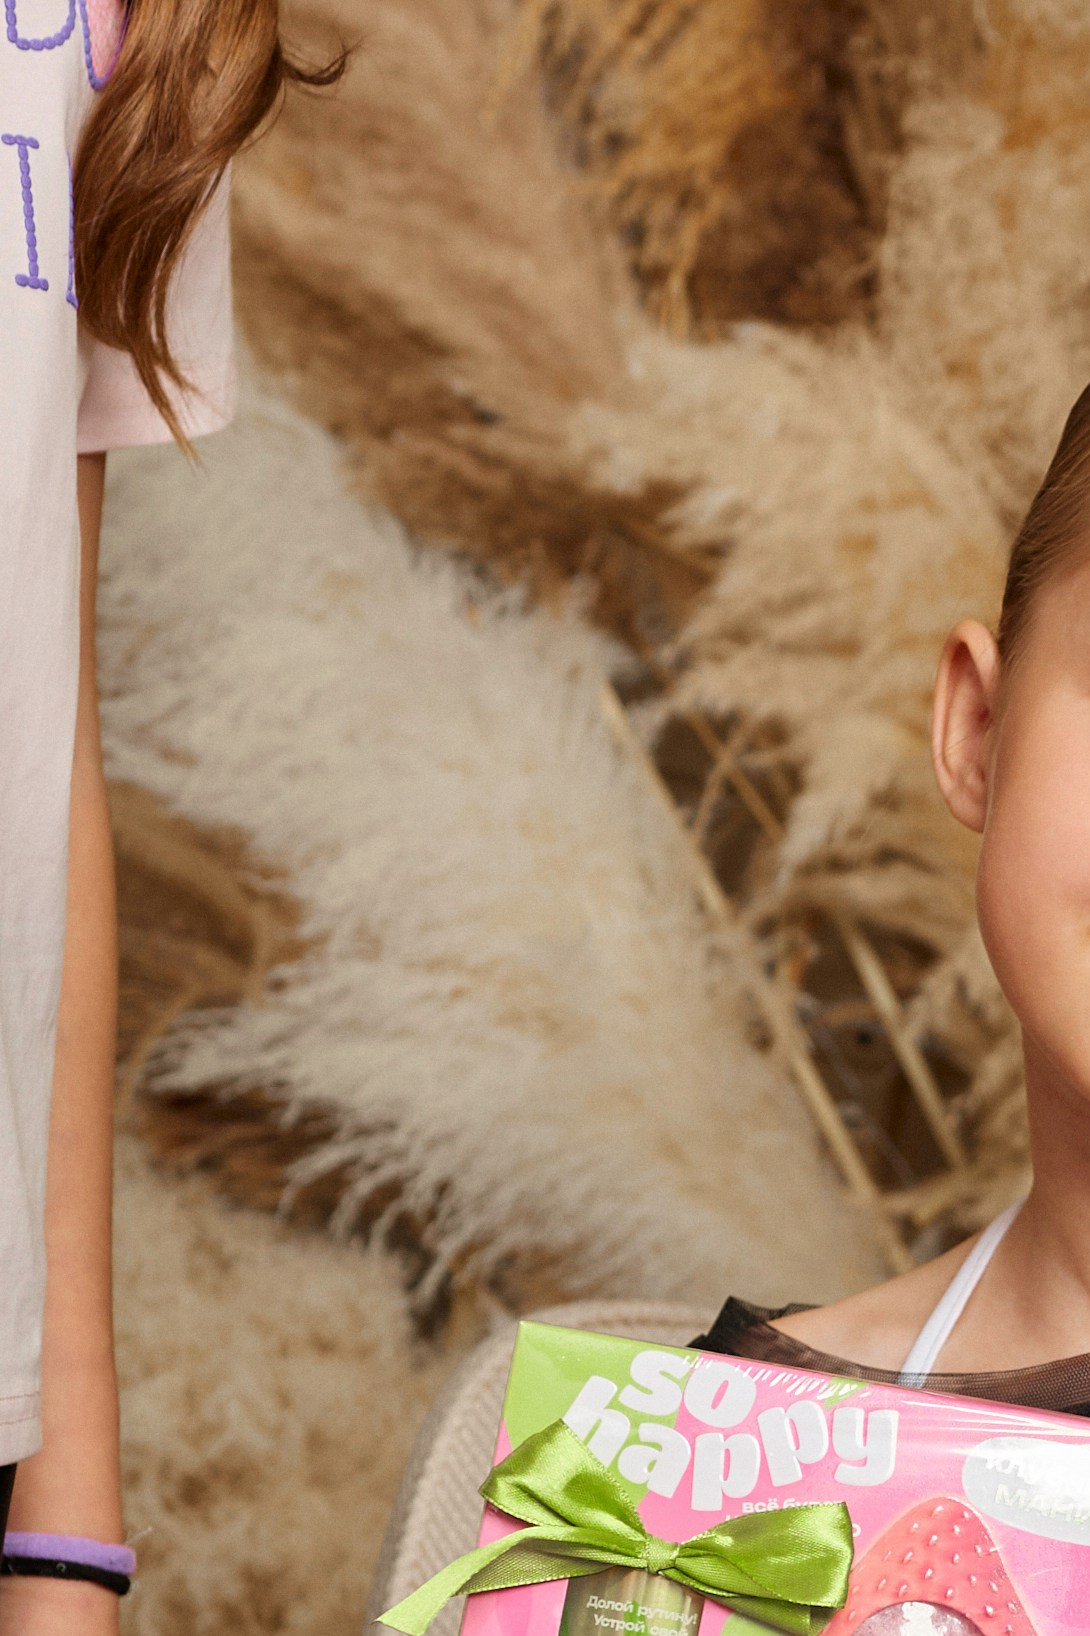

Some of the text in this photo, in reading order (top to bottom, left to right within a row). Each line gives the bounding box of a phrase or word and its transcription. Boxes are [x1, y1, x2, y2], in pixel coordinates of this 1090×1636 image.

[562, 1374, 900, 1512] happy
[586, 1595, 698, 1626] Долой рутину!
[594, 1614, 646, 1633] Устрой
